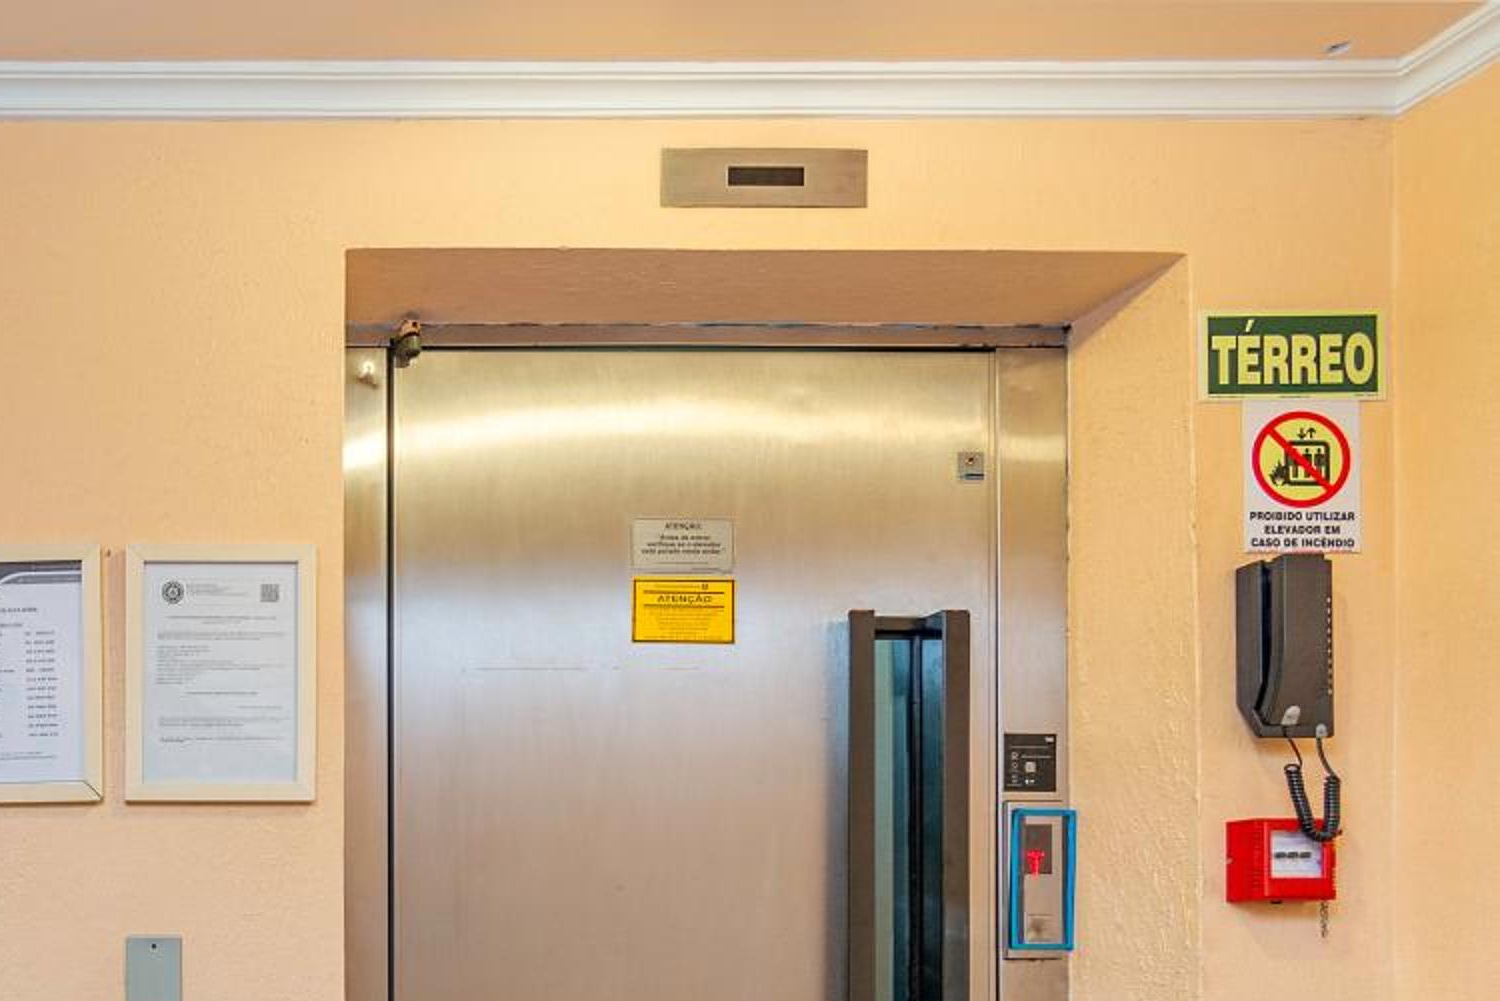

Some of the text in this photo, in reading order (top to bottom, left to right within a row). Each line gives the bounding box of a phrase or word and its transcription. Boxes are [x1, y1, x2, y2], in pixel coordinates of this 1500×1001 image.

[1211, 319, 1374, 385] TÉRREO
[1249, 511, 1355, 521] PROIBIDO UTILIZAR
[1264, 525, 1341, 534] ELEVADOR EM
[1251, 536, 1355, 548] CASO DE INCÊNDIO
[657, 594, 712, 604] ATENÇÃO
